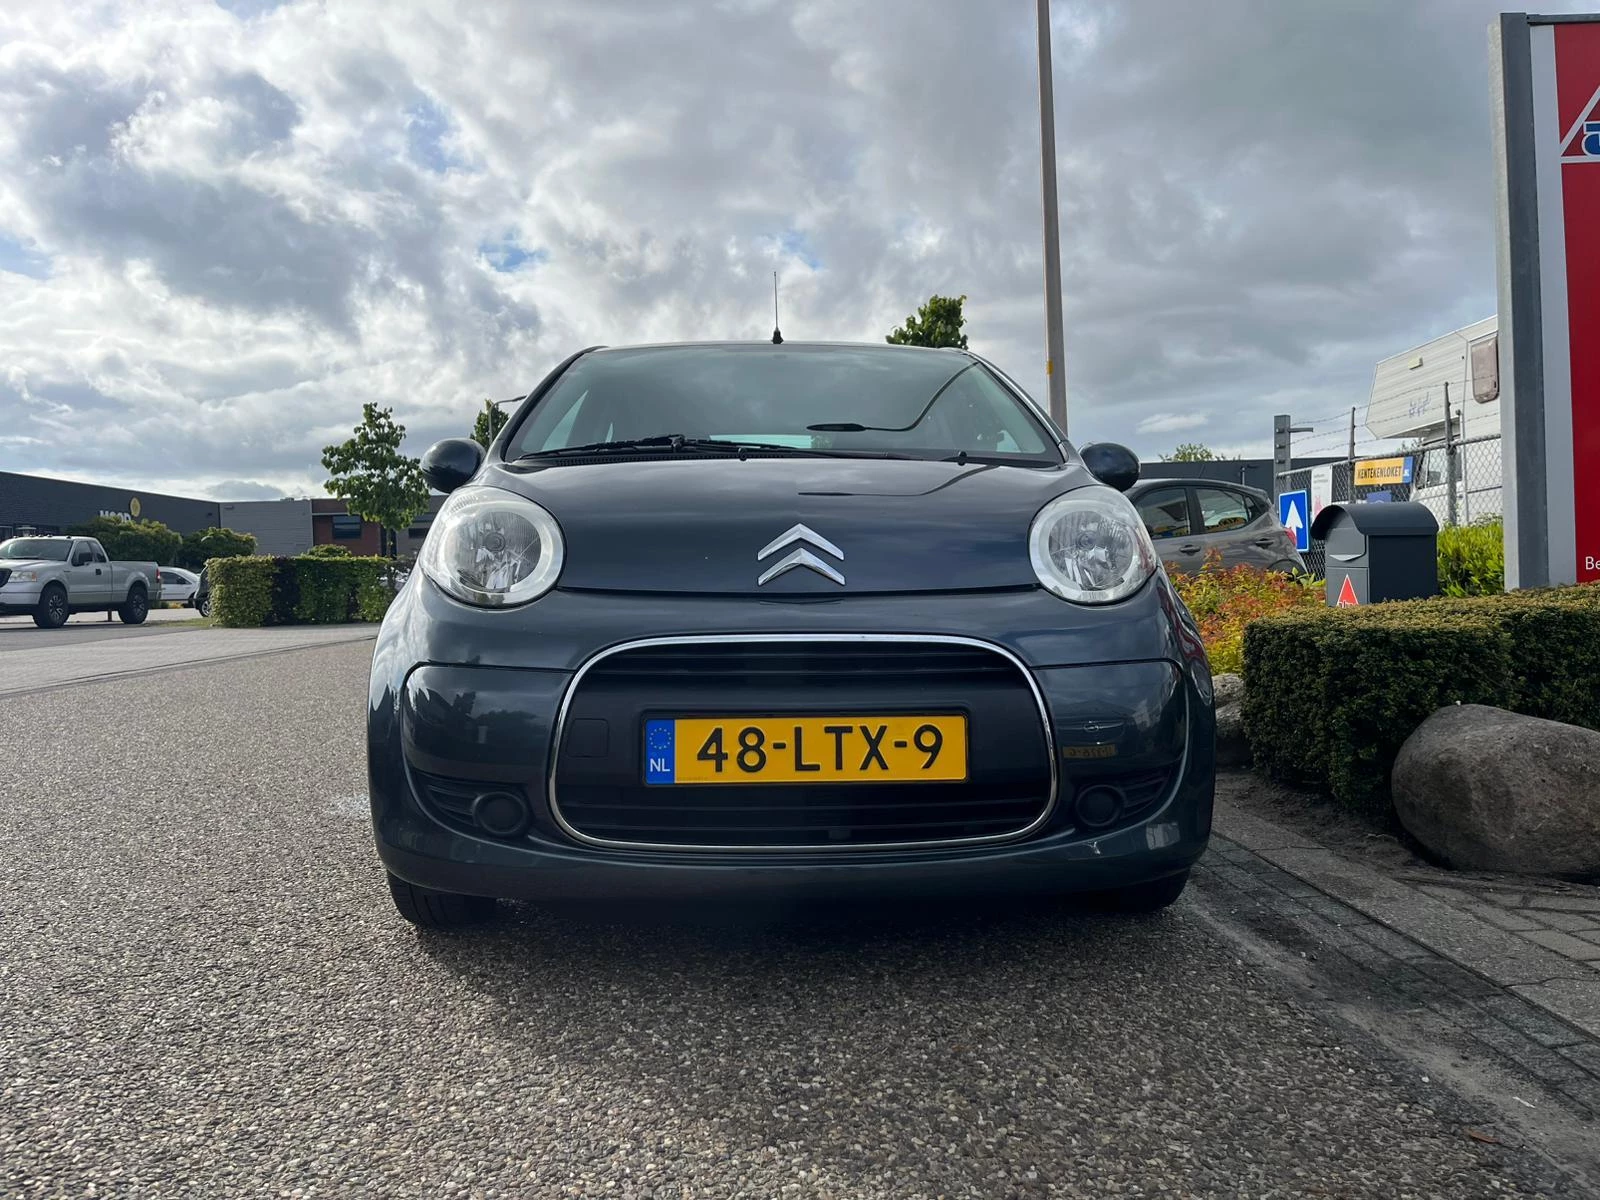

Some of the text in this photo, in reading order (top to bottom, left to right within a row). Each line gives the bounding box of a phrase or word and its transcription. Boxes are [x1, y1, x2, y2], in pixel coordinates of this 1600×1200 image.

[1358, 466, 1402, 479] KENTEKENLOKET
[697, 724, 943, 773] 48-LTX-9
[650, 758, 671, 772] NL
